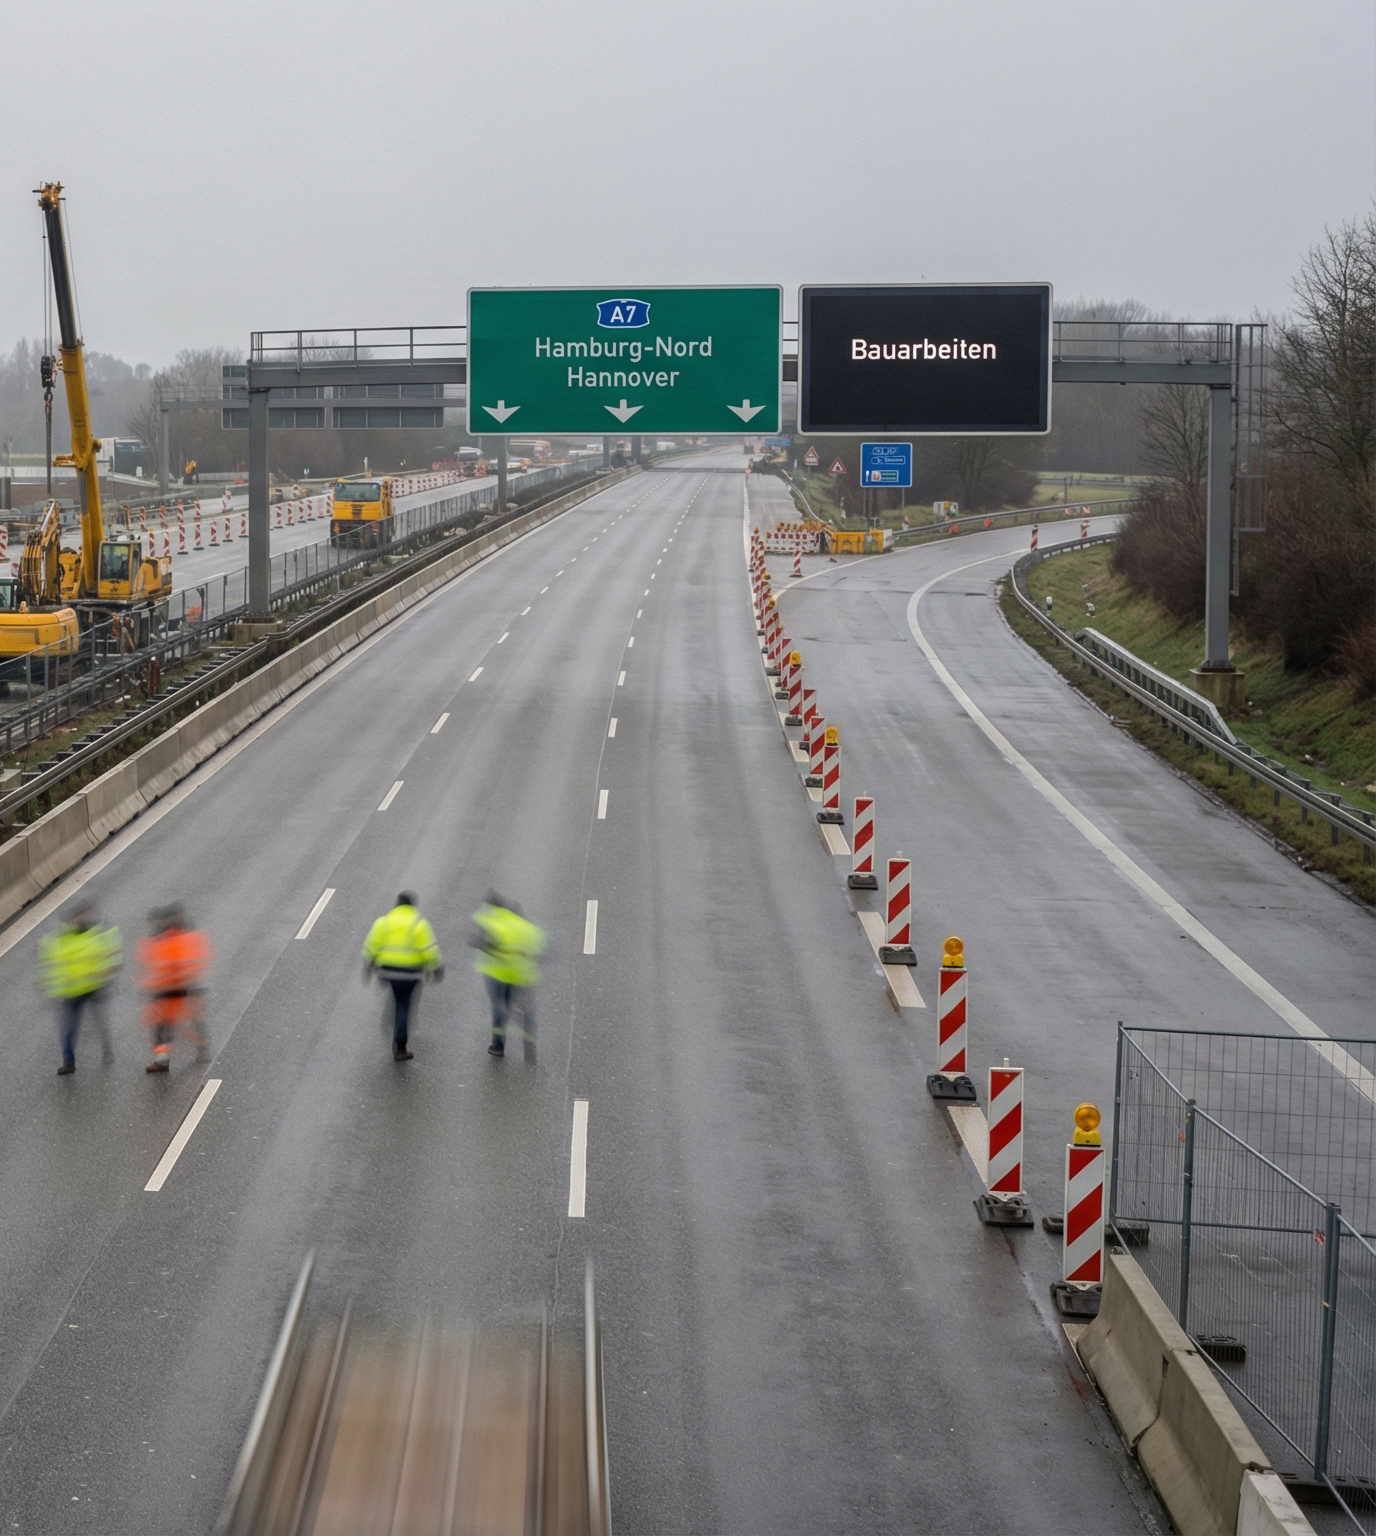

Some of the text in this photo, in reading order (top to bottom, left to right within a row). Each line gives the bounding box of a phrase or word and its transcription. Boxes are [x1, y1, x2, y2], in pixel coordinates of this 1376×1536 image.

[611, 306, 637, 323] A7
[535, 336, 712, 362] Hamburg-Nord
[851, 338, 997, 360] Bauarbeiten
[567, 366, 680, 387] Hannover
